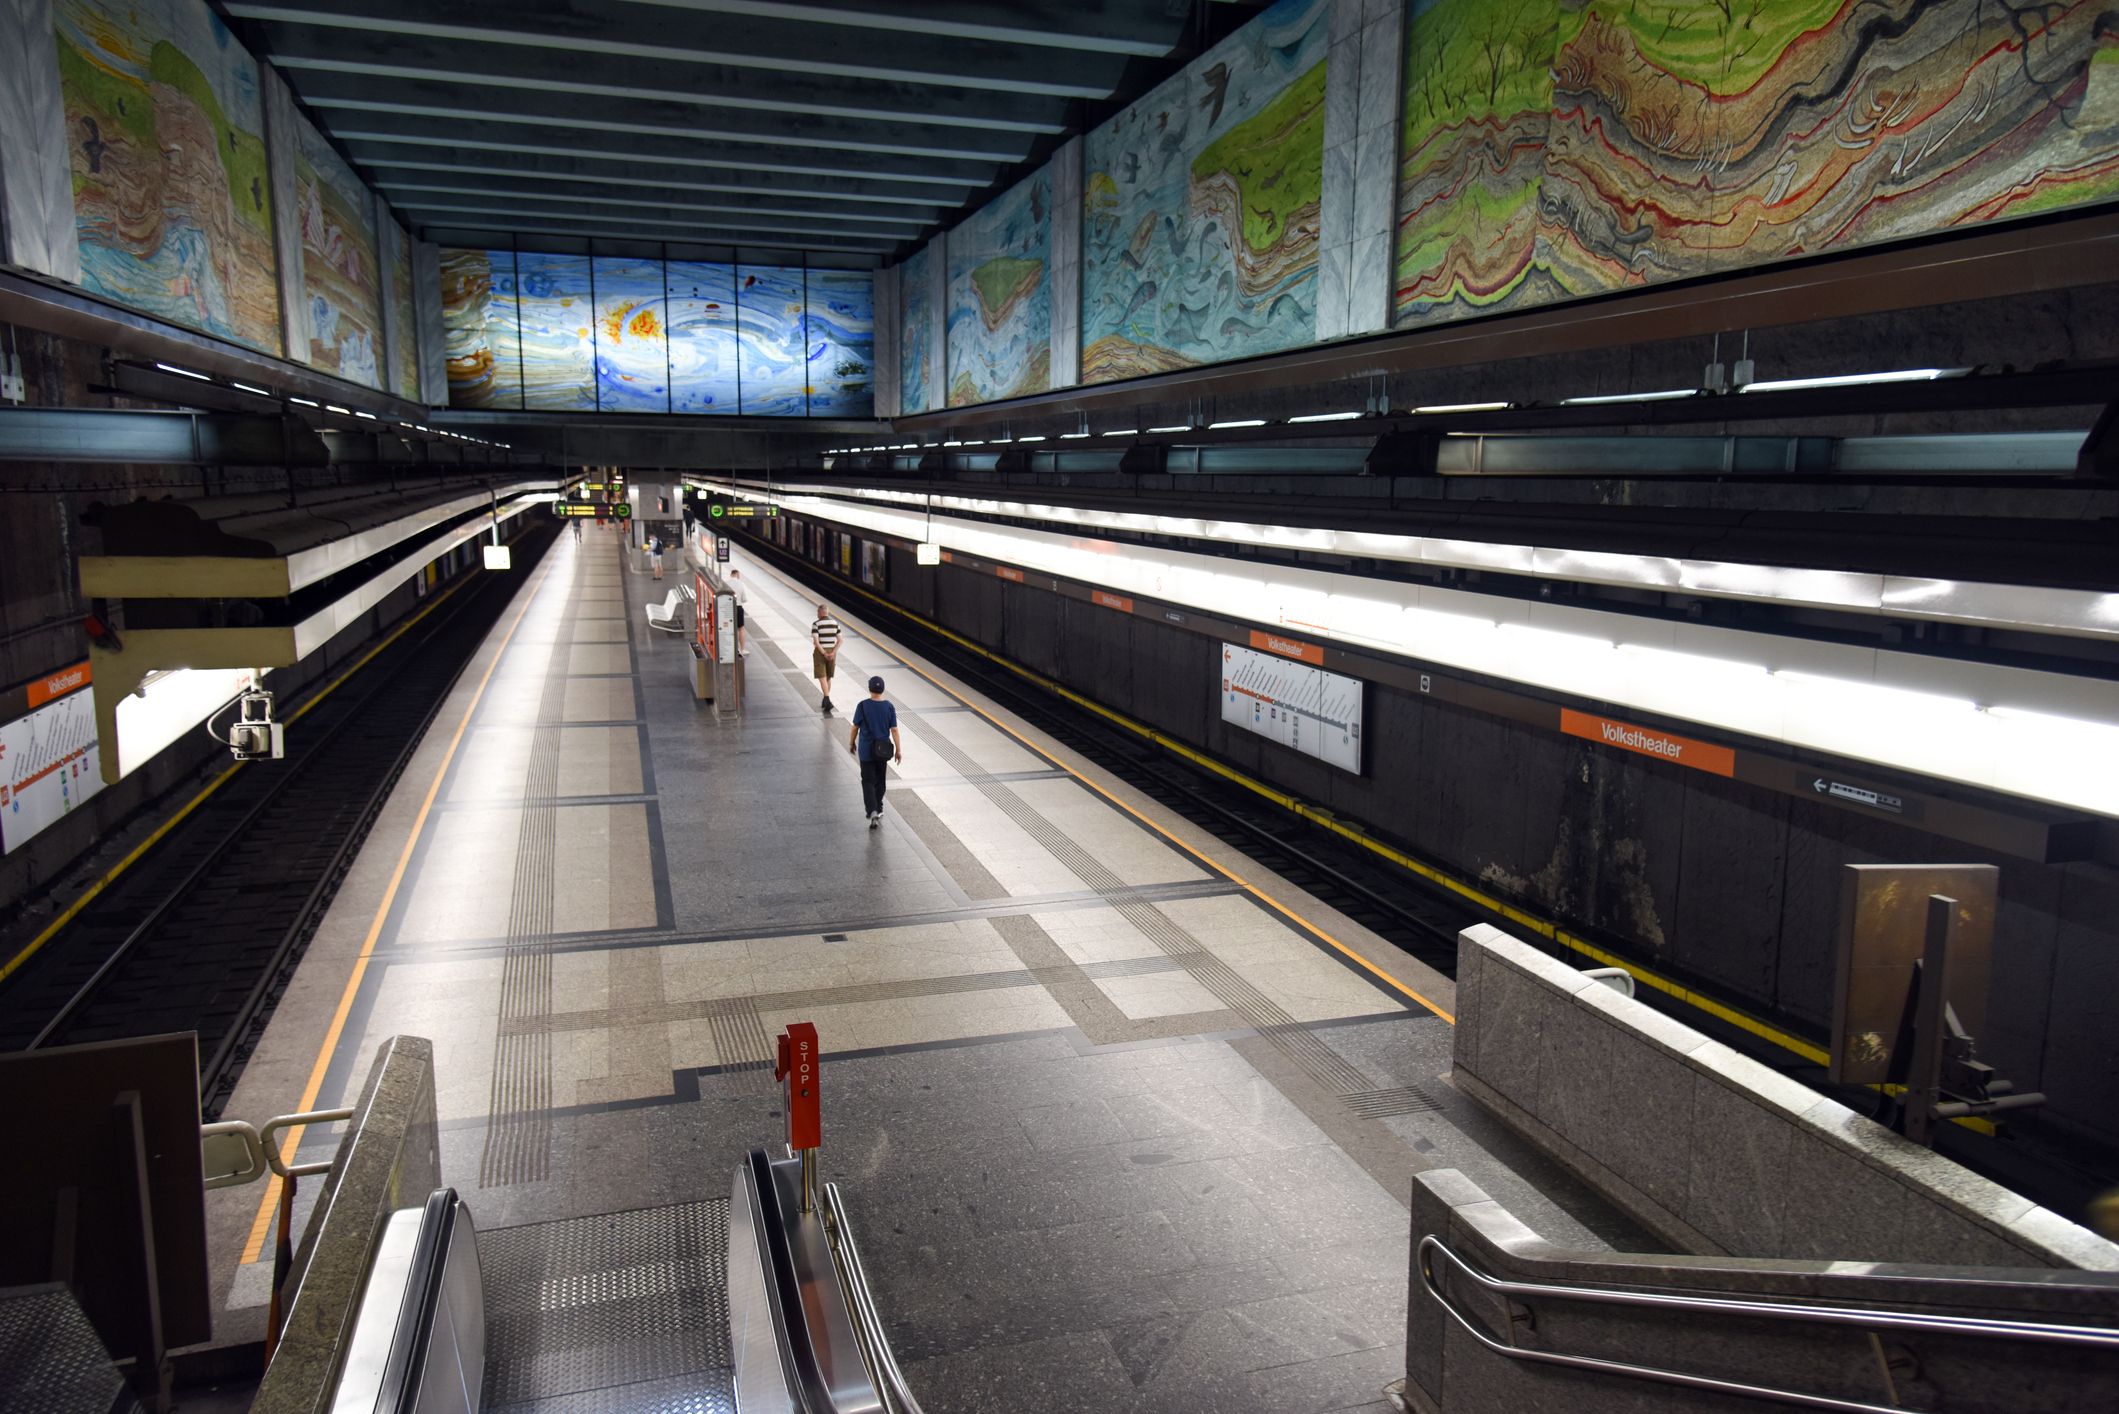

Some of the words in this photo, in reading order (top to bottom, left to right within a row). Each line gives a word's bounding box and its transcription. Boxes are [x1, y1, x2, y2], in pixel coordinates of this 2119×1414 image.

[1267, 636, 1303, 656] Volkstheater
[47, 671, 82, 694] Volkstheater
[1601, 722, 1682, 758] Volkstheater
[800, 1041, 810, 1085] STOP
